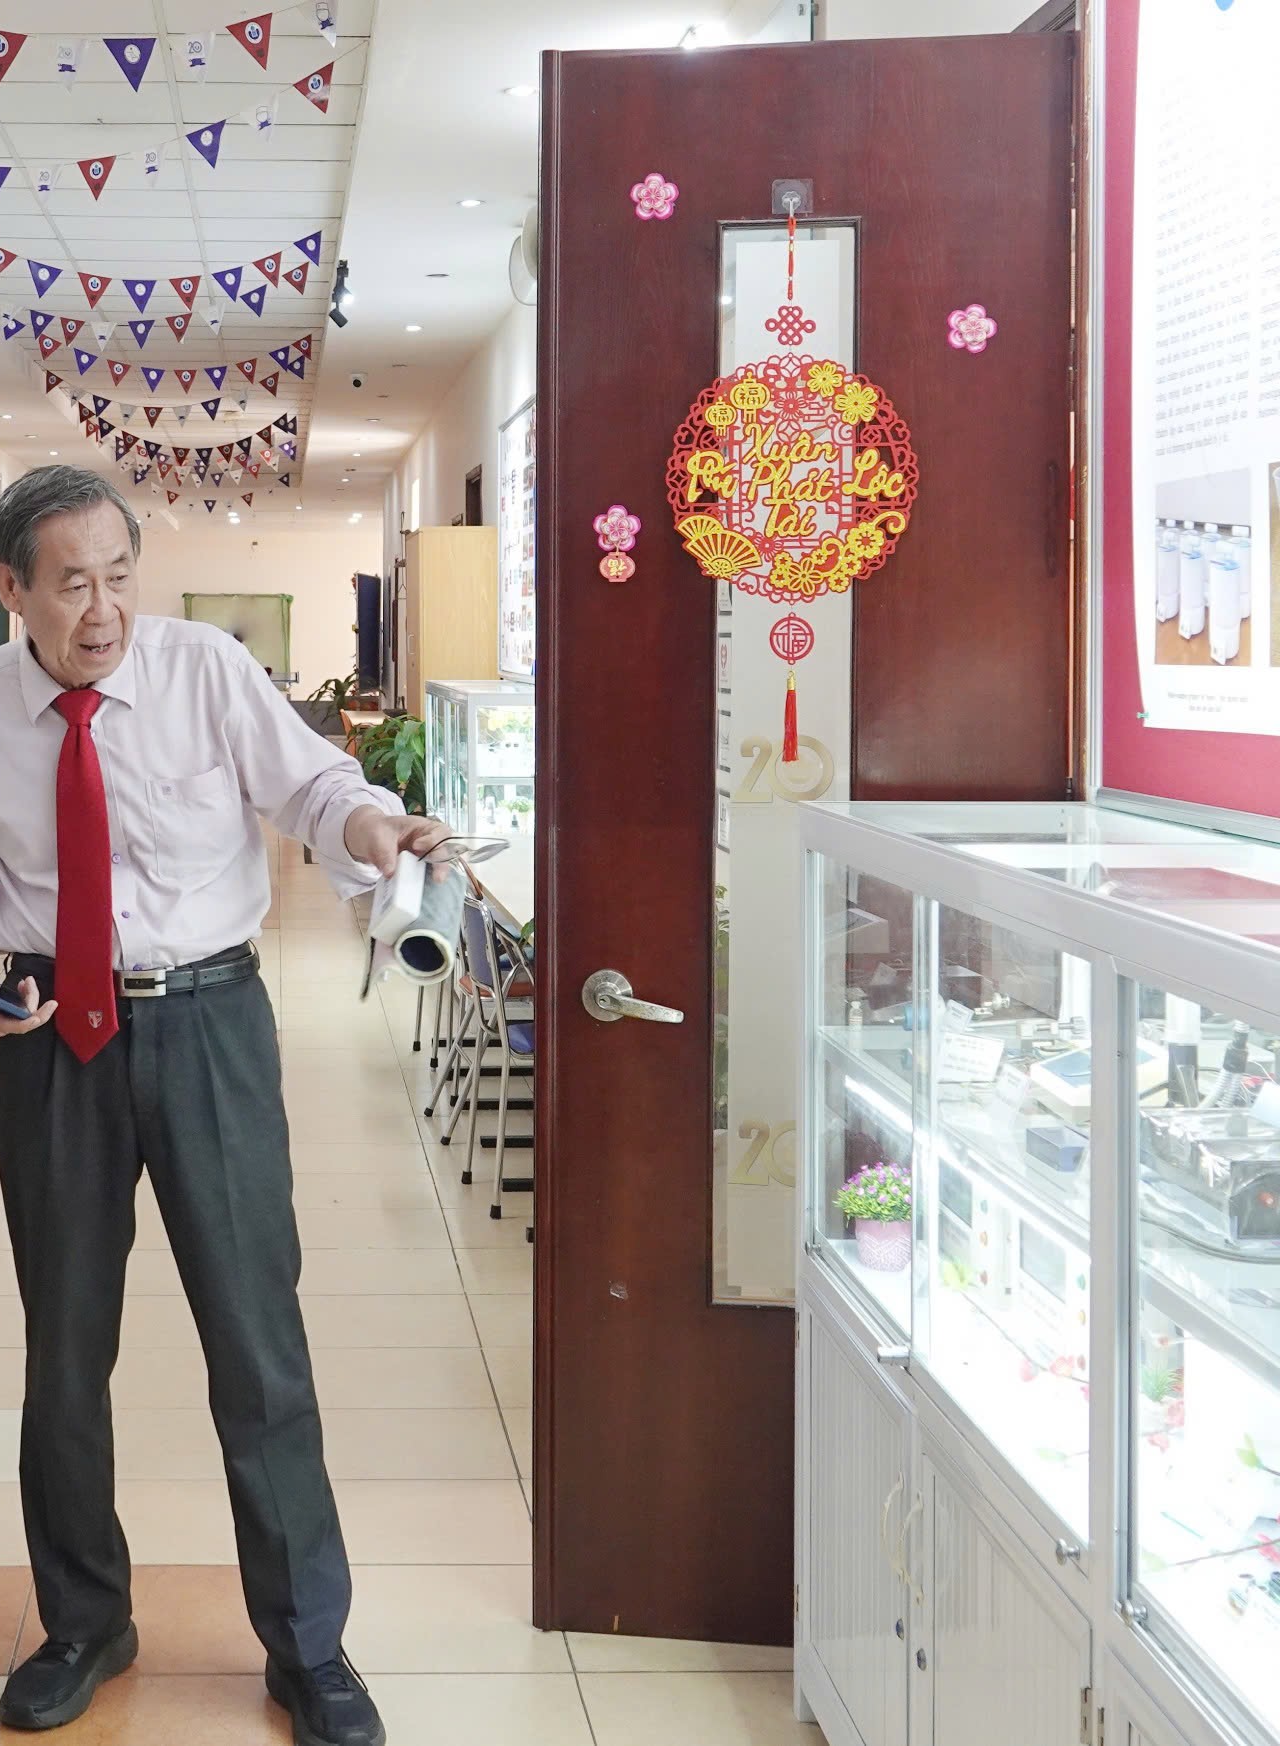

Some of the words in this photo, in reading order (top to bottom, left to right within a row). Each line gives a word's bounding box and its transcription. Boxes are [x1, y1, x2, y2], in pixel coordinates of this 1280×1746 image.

[188, 41, 202, 53] 20
[742, 422, 839, 465] Xuân
[747, 457, 834, 502] Phát
[842, 449, 906, 502] Lộc
[762, 498, 817, 539] Tài
[729, 734, 834, 803] 20
